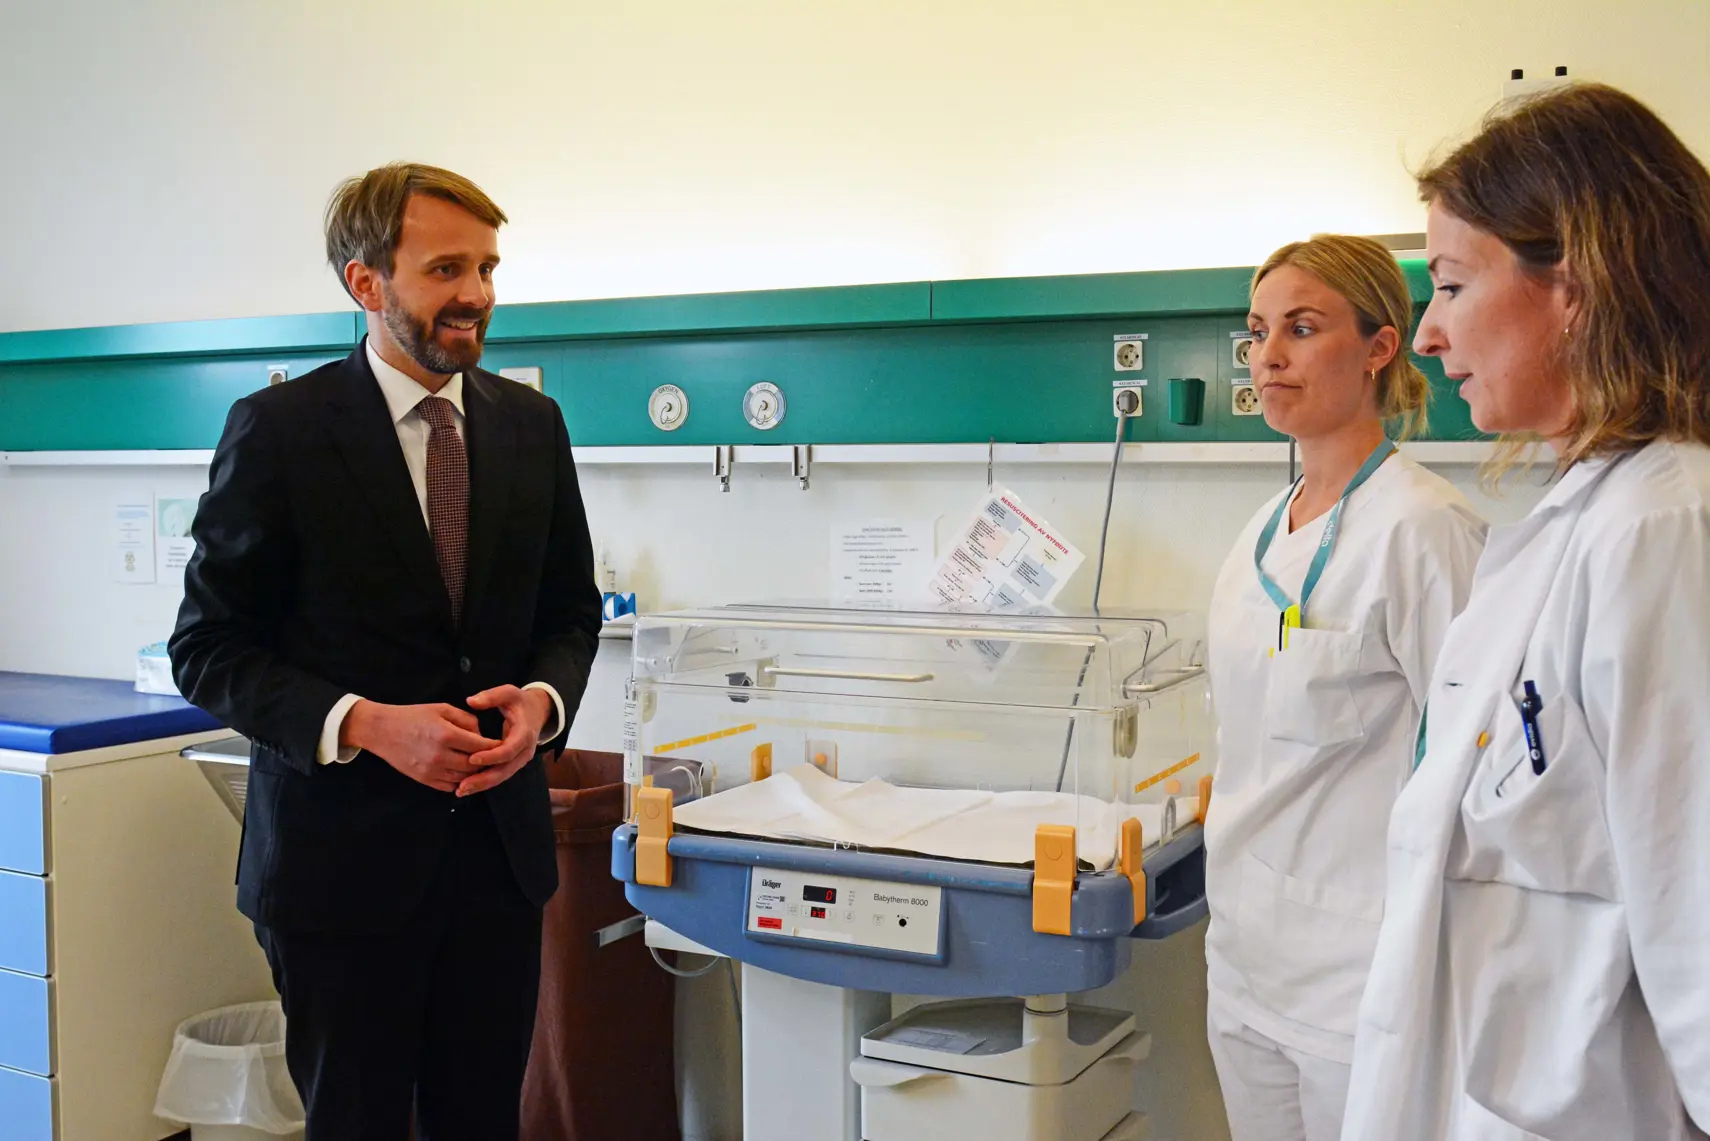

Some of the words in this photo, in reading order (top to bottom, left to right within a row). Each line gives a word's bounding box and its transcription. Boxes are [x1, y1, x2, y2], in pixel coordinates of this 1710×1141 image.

[658, 386, 679, 394] OXYGEN
[1001, 496, 1038, 529] RESUSCITERING
[1037, 527, 1047, 536] AV
[1045, 533, 1069, 556] NYFØDTE
[762, 879, 781, 889] Dräger
[825, 889, 833, 902] 0
[873, 893, 909, 904] Babytherm
[911, 897, 929, 907] 8000
